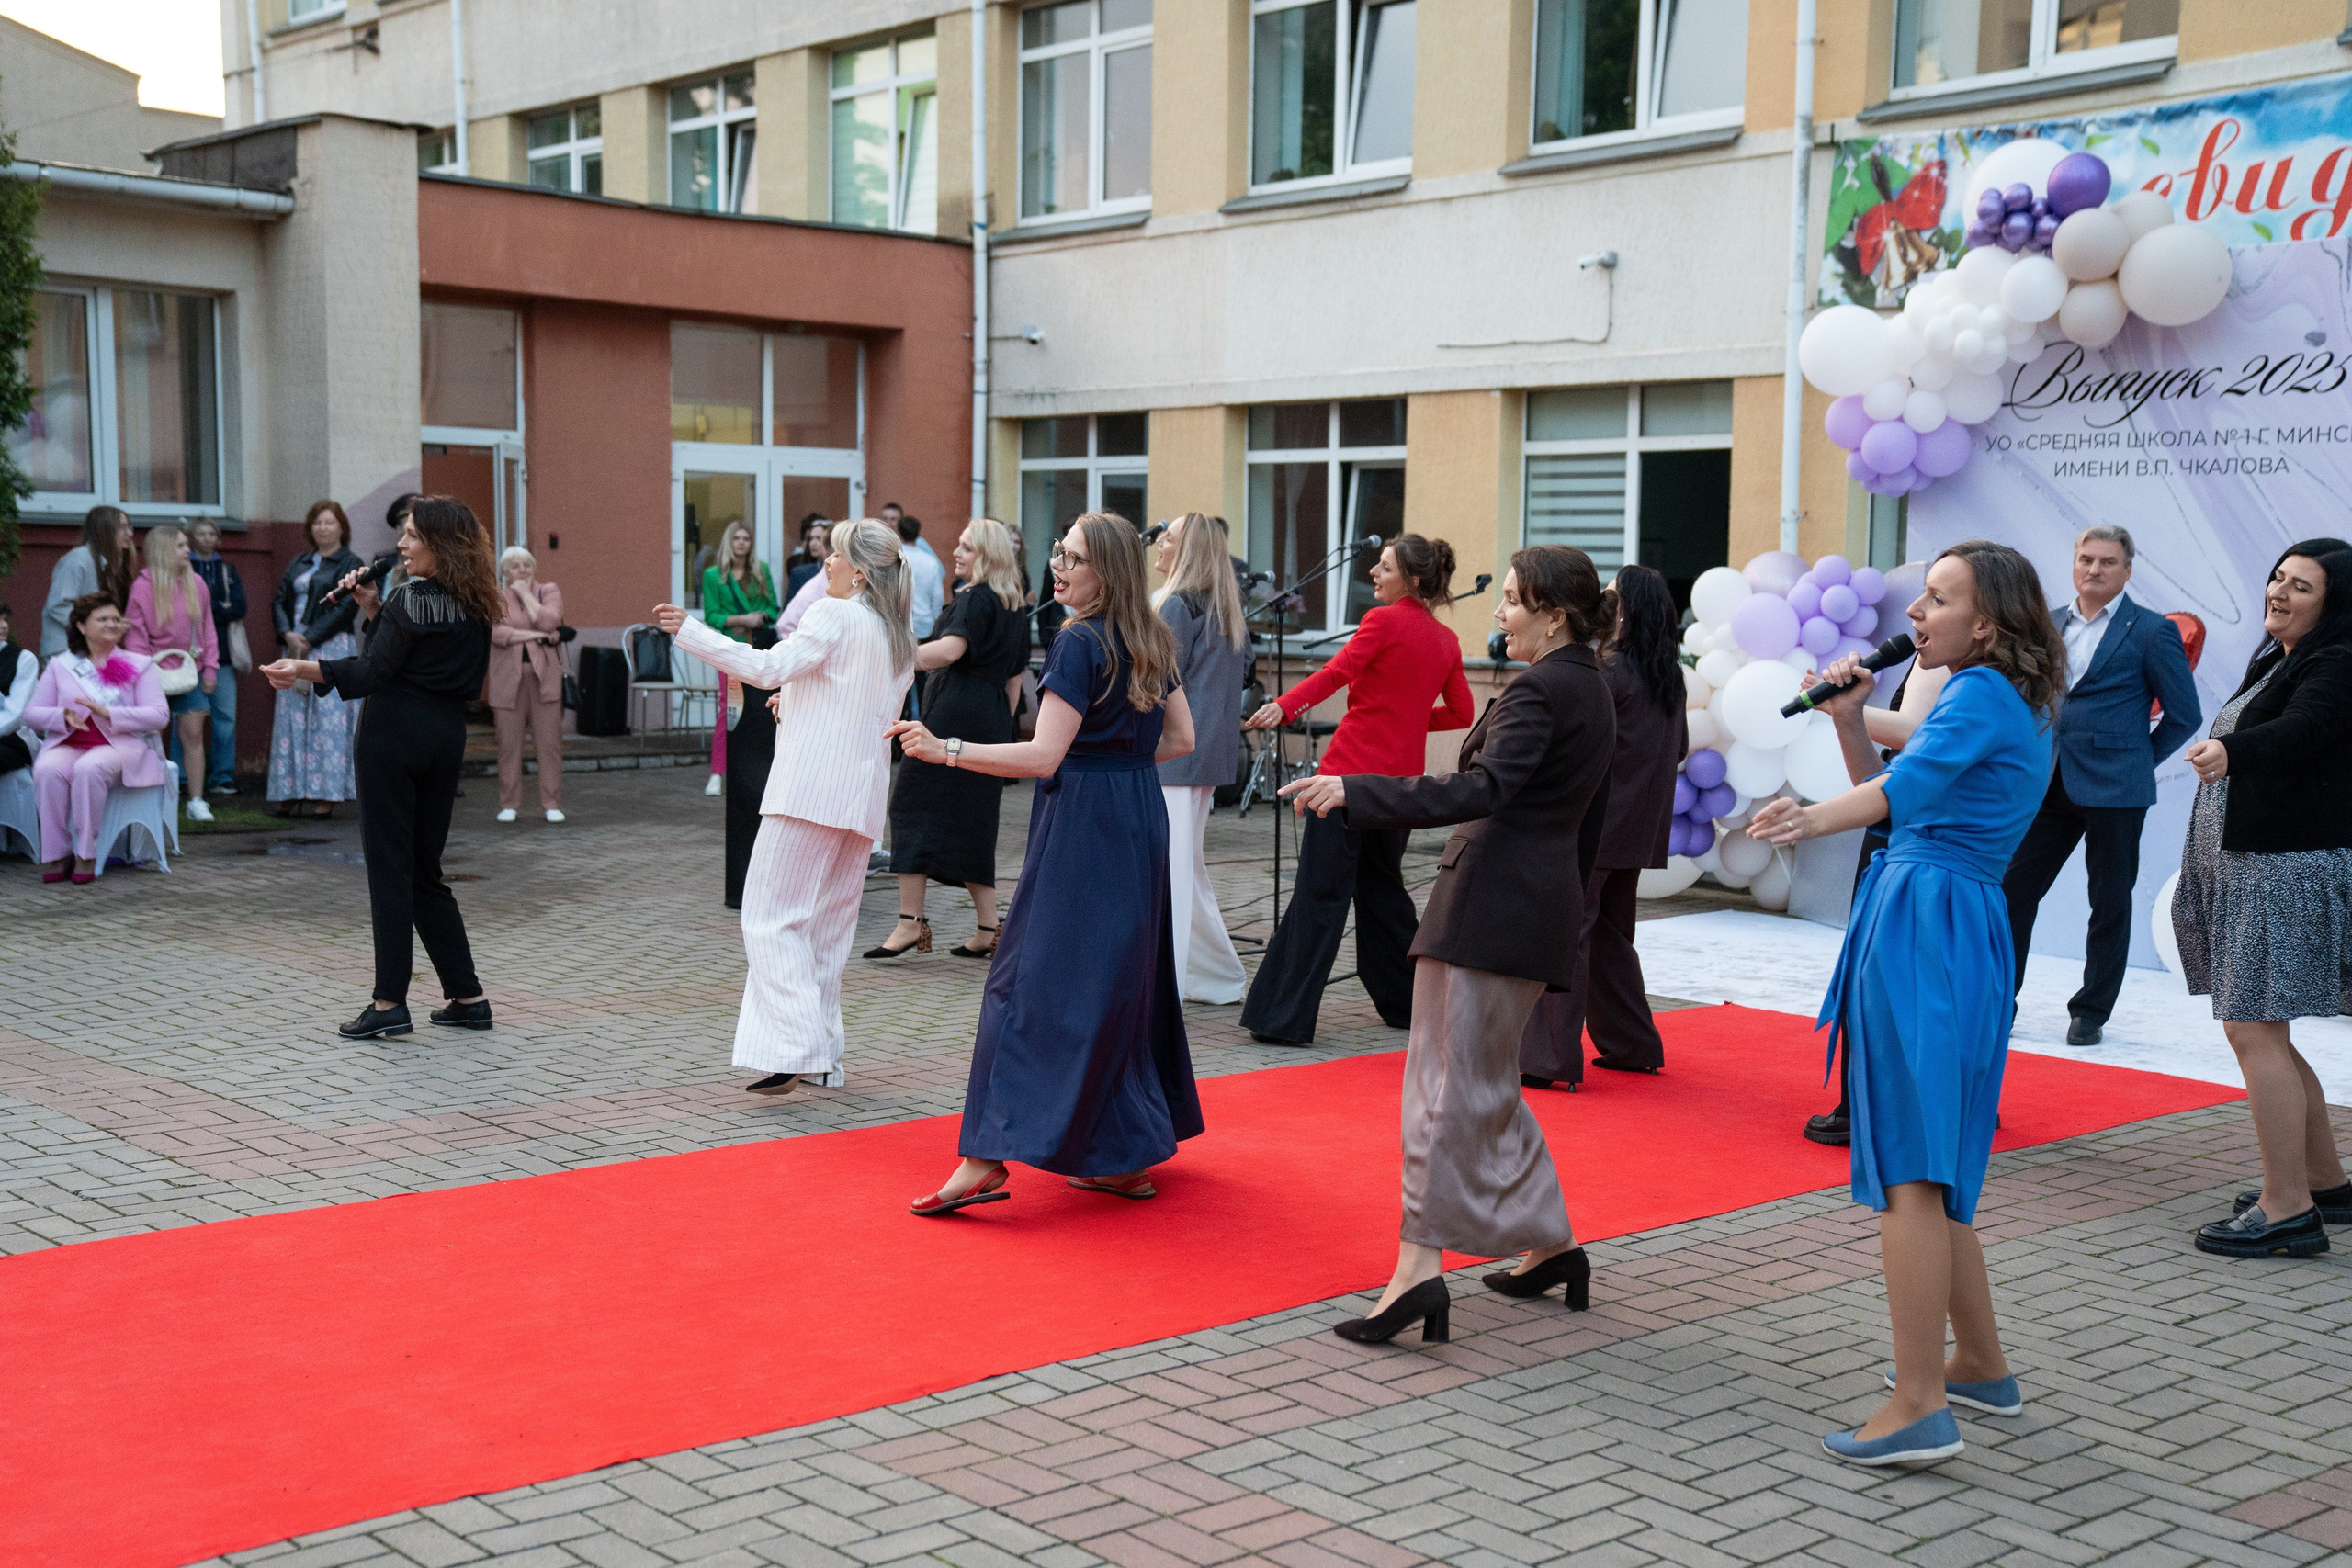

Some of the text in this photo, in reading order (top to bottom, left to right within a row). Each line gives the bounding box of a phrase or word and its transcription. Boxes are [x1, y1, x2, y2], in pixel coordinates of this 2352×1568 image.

[2141, 118, 2352, 242] вид
[2001, 340, 2222, 429] Выпуск
[1985, 434, 2012, 452] УО
[2017, 432, 2120, 453] «СРЕДНЯЯ
[2127, 429, 2208, 449] ШКОЛА
[2277, 424, 2352, 445] МИНС
[2054, 456, 2290, 479] ИМЕНИ В.П. ЧКАЛОВА
